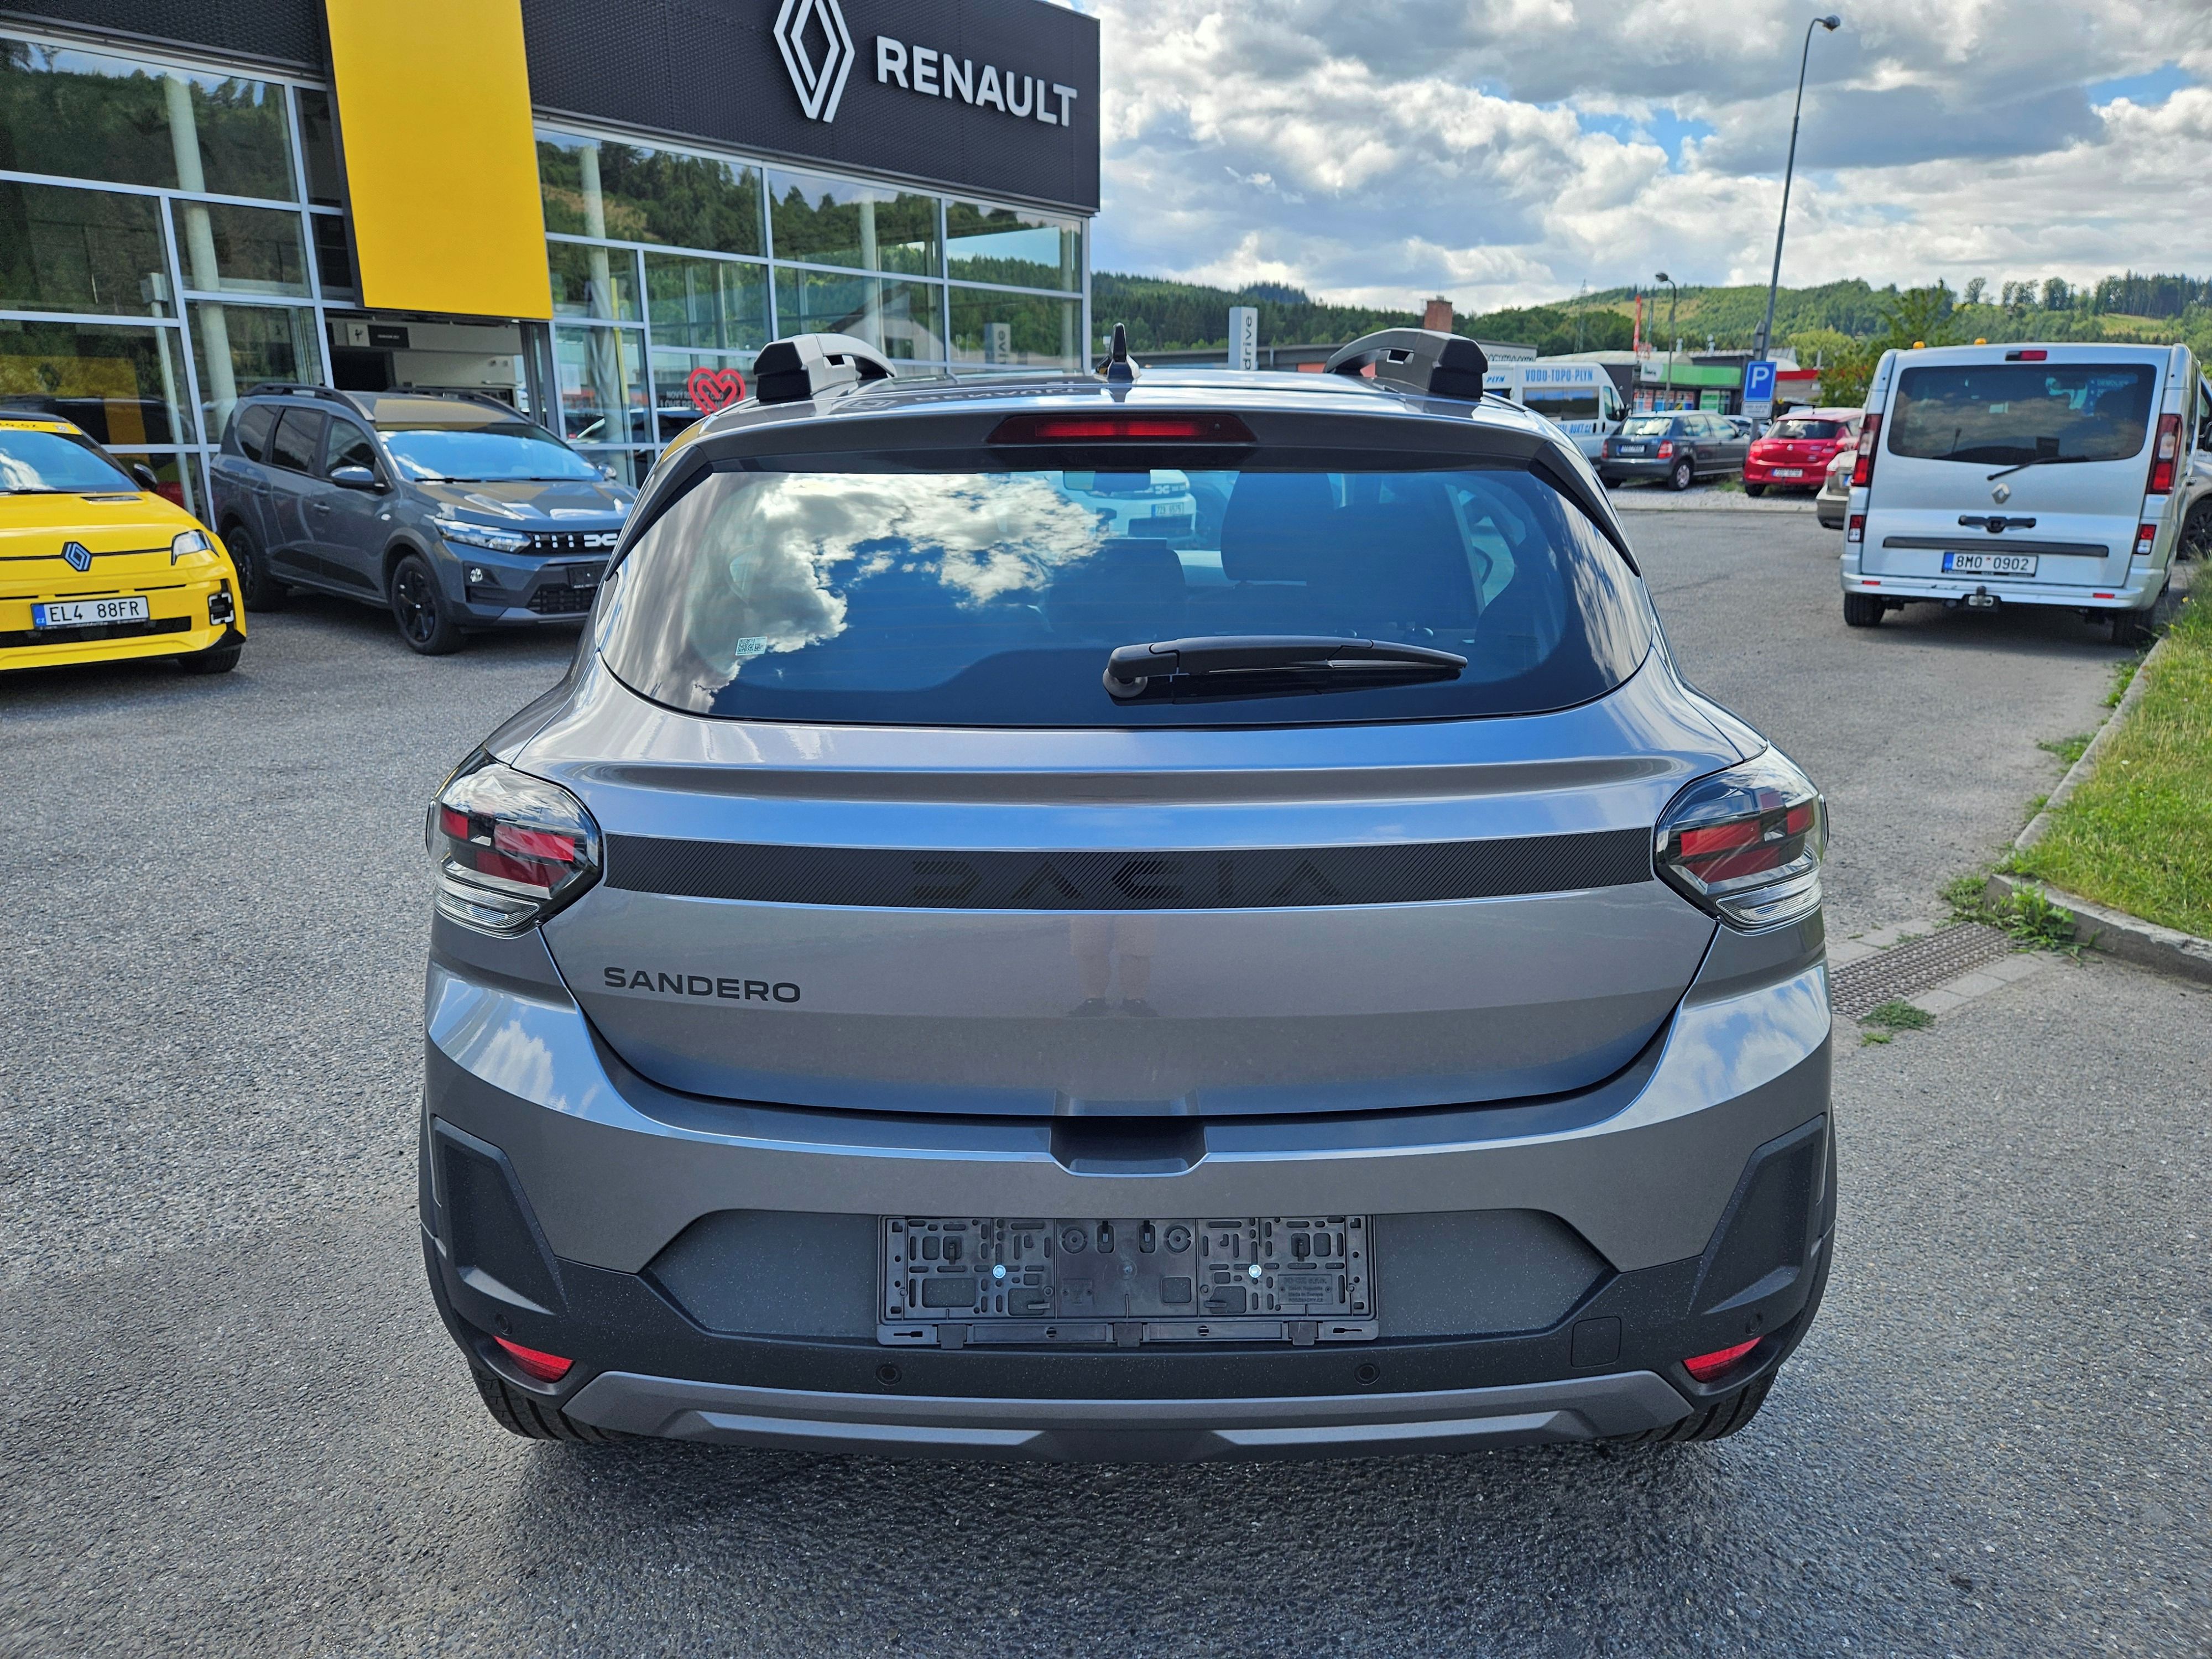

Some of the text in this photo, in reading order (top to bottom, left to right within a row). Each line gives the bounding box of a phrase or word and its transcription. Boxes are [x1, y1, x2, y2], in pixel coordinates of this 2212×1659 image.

[877, 35, 1078, 127] RENAULT
[1243, 315, 1253, 370] drive
[1751, 366, 1770, 389] P
[1993, 557, 2029, 571] 0902
[49, 601, 139, 622] EL4 88FR
[912, 859, 1344, 900] DACIA
[604, 967, 800, 1003] SANDERO
